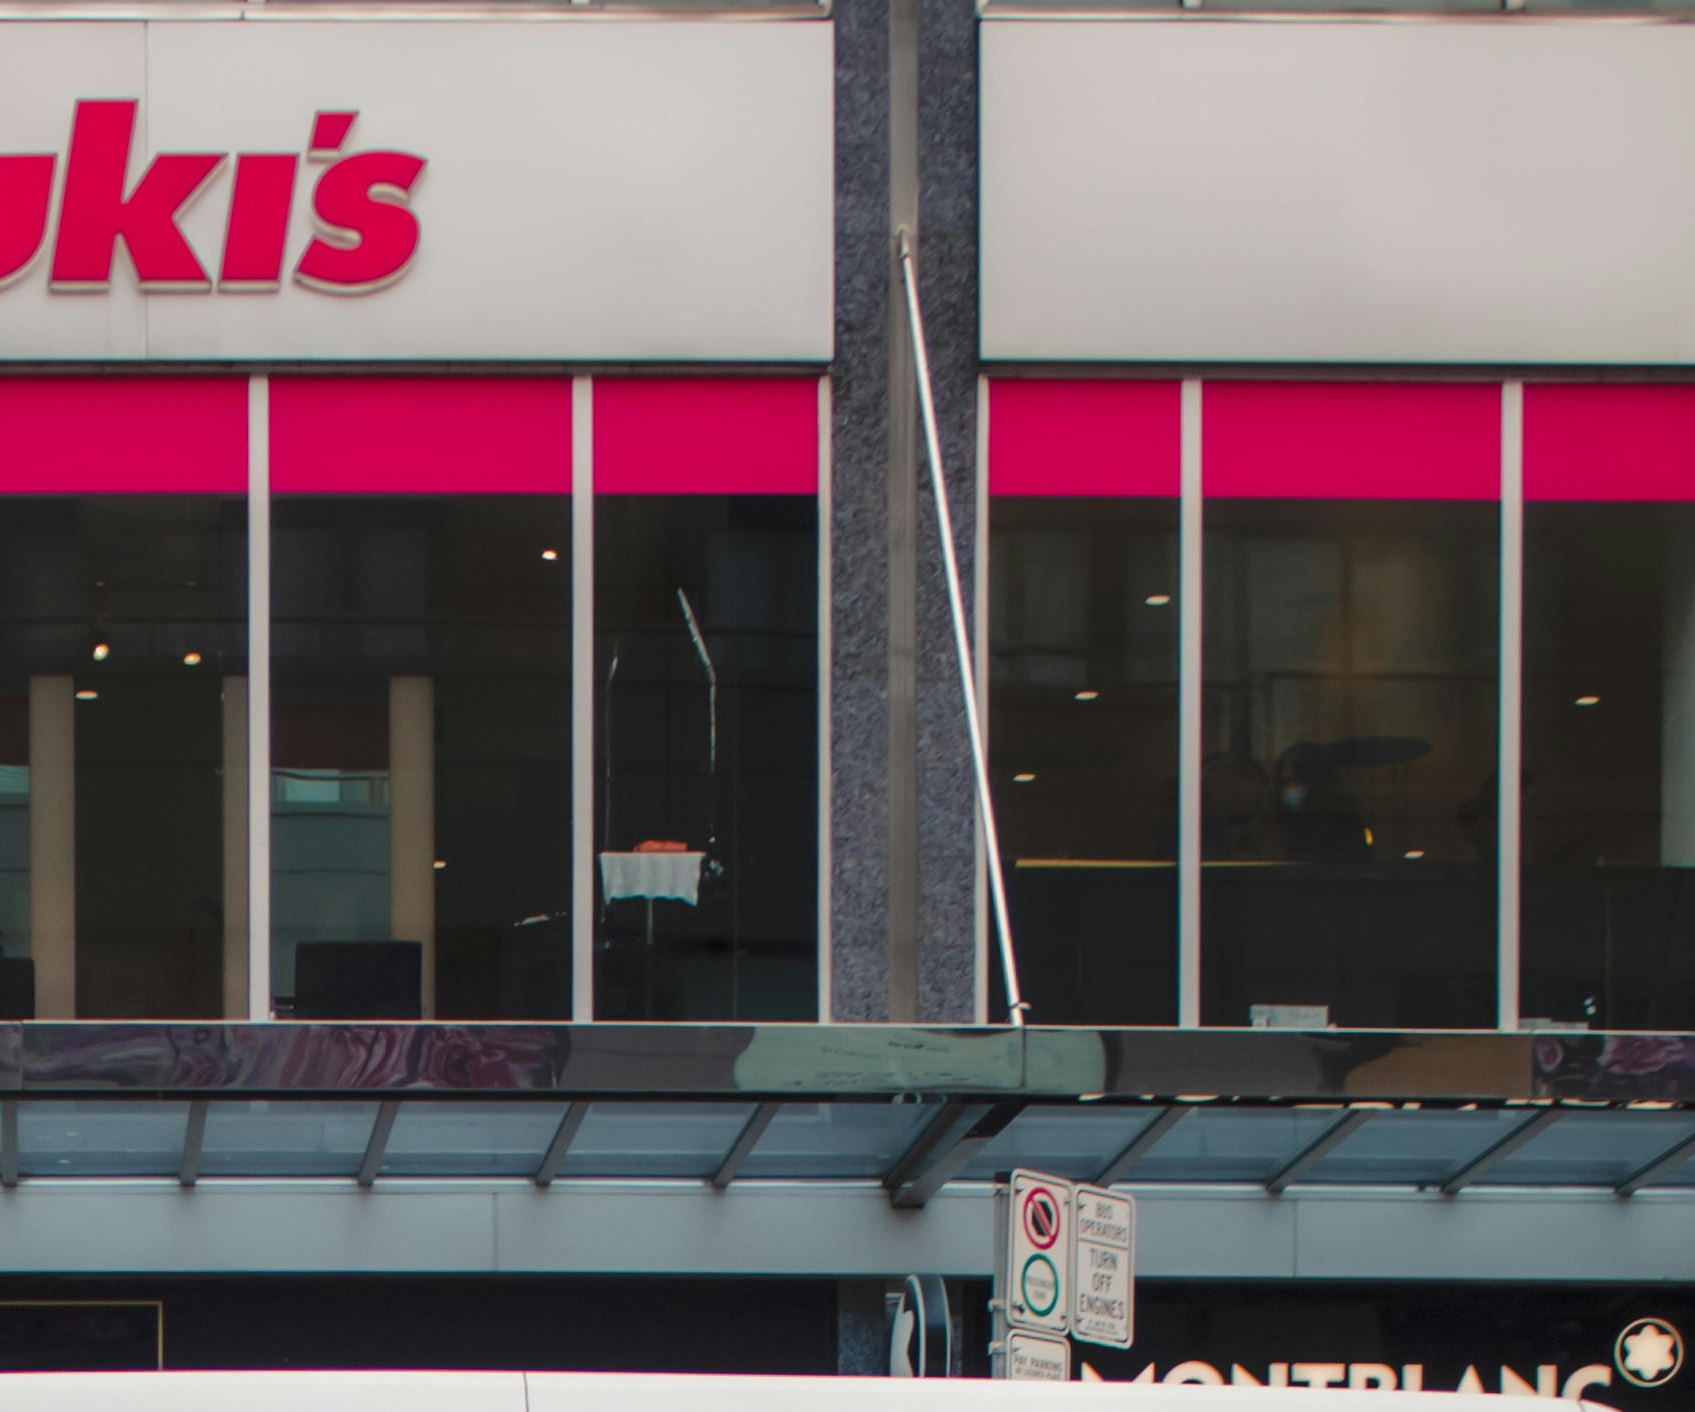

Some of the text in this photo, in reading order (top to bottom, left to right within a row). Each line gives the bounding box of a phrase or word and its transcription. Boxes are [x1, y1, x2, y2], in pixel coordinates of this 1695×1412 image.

[1089, 1247, 1118, 1271] TURN
[1092, 1272, 1113, 1293] OFF
[1079, 1293, 1124, 1320] ENGINES
